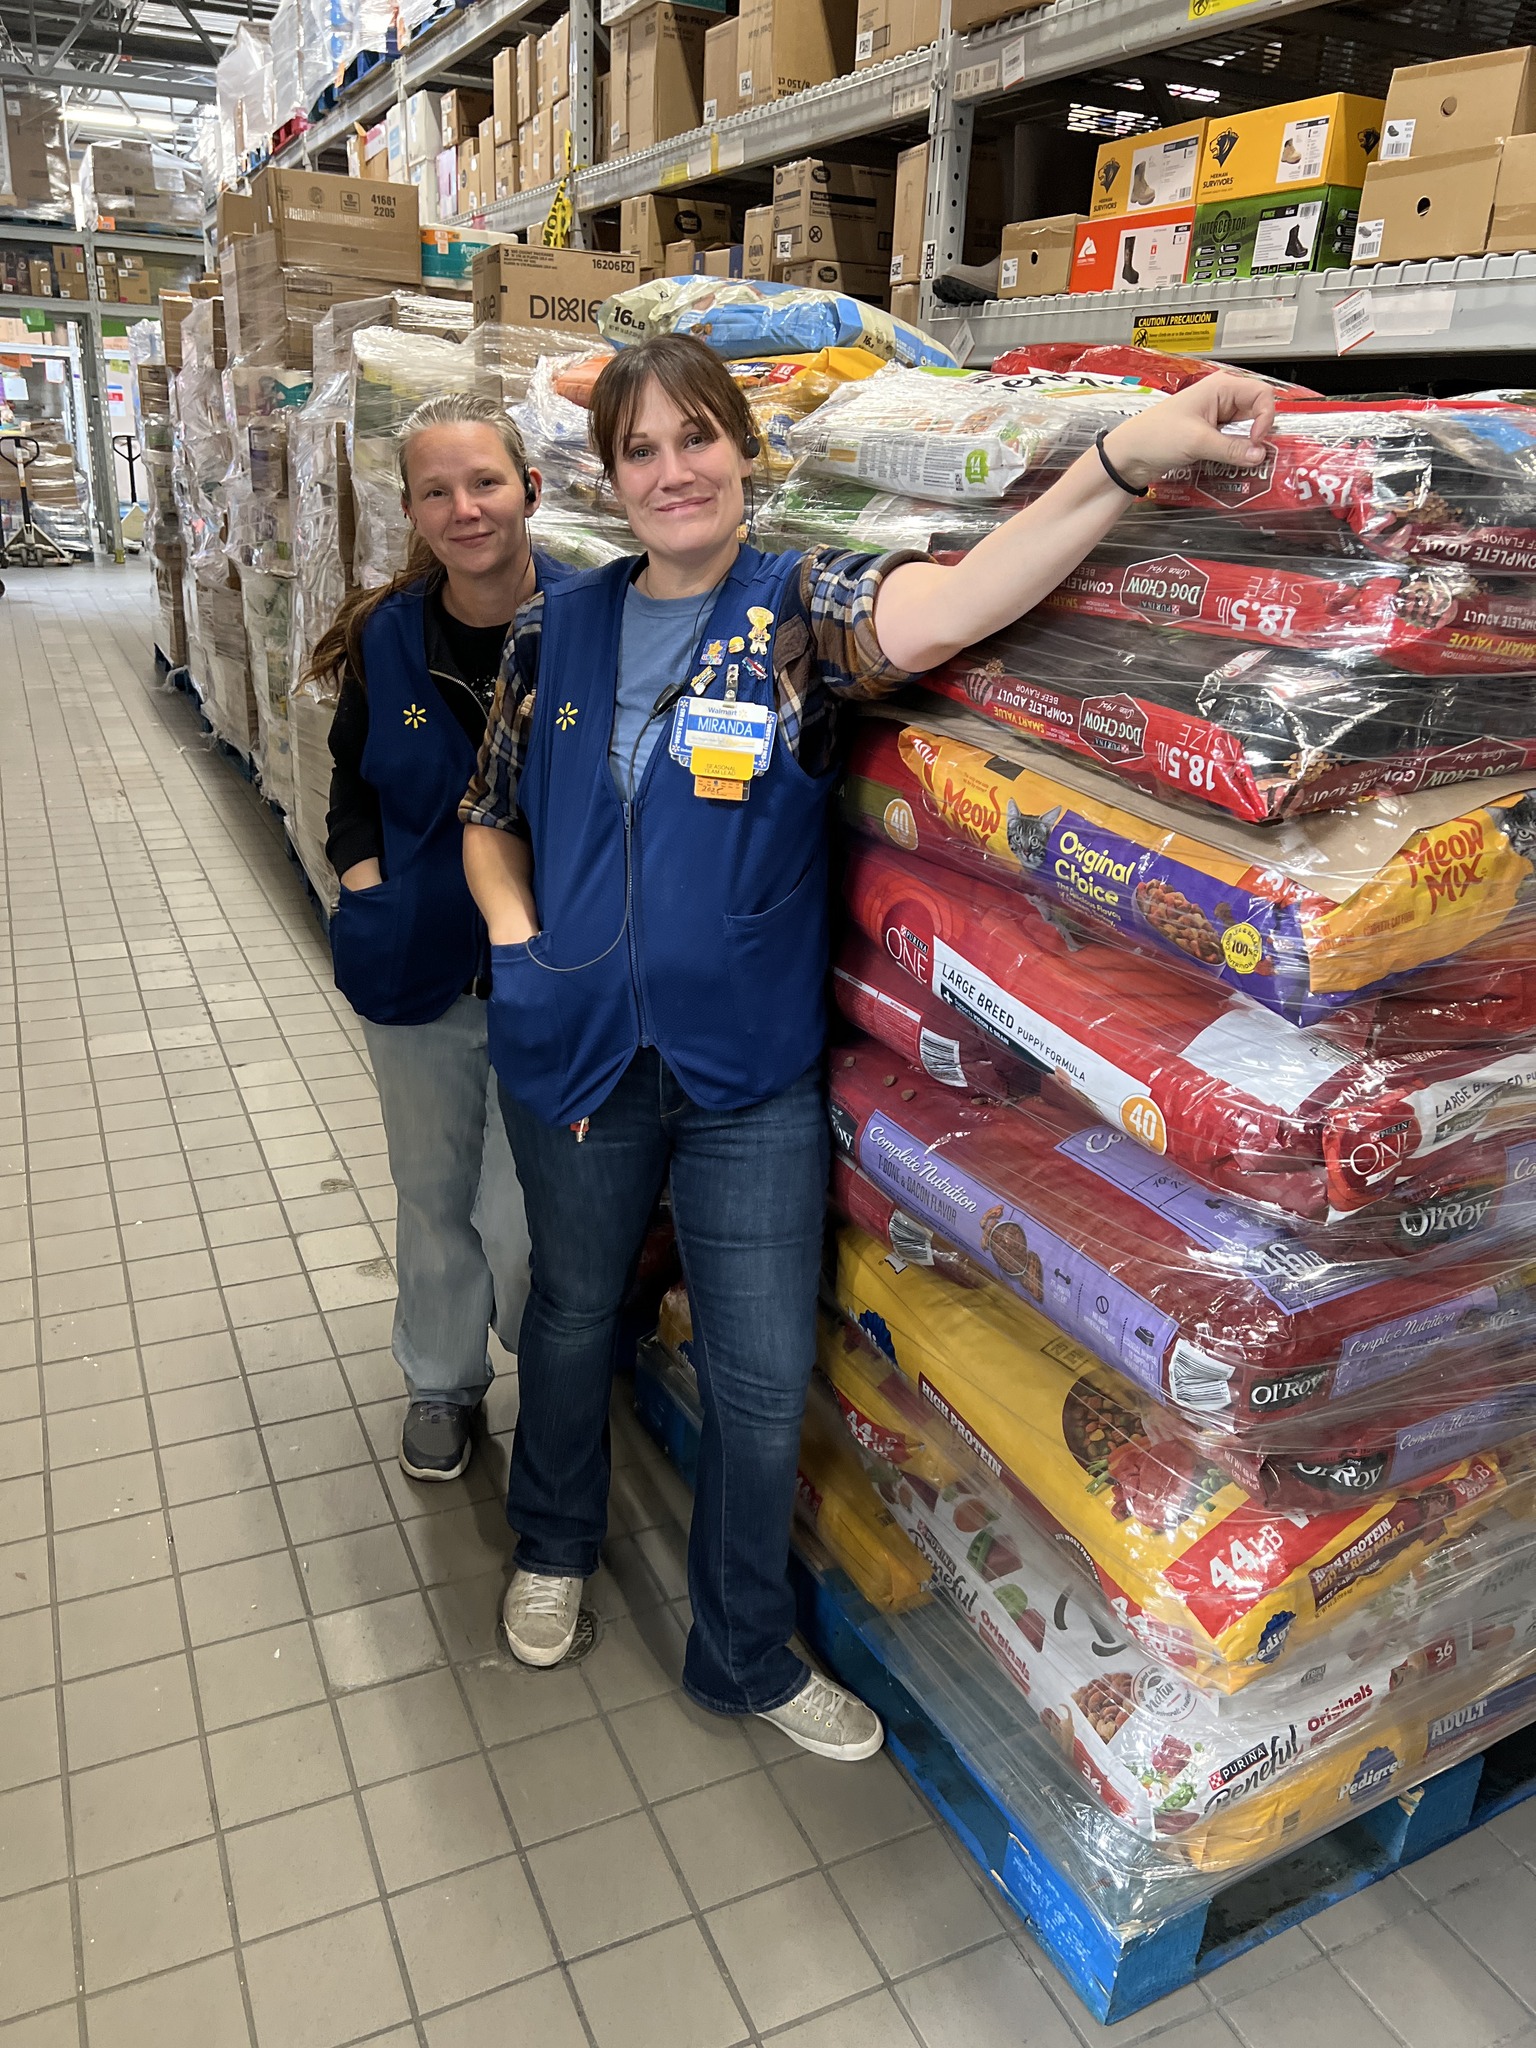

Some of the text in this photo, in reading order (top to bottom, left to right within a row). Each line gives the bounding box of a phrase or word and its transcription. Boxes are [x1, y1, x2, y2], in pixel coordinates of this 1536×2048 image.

[371, 193, 397, 207] 41681
[1203, 177, 1234, 189] SURVIVORS
[373, 206, 396, 218] 2205
[1093, 202, 1117, 213] SURVIVORS
[1199, 216, 1248, 236] INTERCEPTOR
[592, 258, 635, 274] 16206 24
[1138, 315, 1167, 327] CAUTION
[1170, 311, 1212, 325] PRECAUCIÓN
[1482, 534, 1526, 548] FLAVOR
[1125, 576, 1201, 605] DOG CHOW
[1463, 610, 1499, 626] ADULT
[1449, 633, 1488, 650] VALUE
[708, 706, 738, 717] Walmart
[996, 687, 1074, 726] COMPLETE ADULT
[1015, 683, 1059, 705] BEEF FLAVOR
[674, 727, 683, 744] WEST
[697, 715, 754, 737] MIRANDA
[993, 705, 1046, 734] SMART VALUE
[1081, 711, 1143, 747] DOG CHOW
[703, 768, 720, 776] TEAM
[943, 777, 1001, 834] Meow
[1059, 831, 1136, 885] Original
[1054, 858, 1120, 907] Choice
[886, 926, 929, 984] ONE
[904, 927, 929, 954] PURINA
[942, 962, 1087, 1083] LARGE BREED PUPPY FORMULA
[1435, 1085, 1471, 1119] LARGE
[1128, 1102, 1158, 1142] 40
[869, 1126, 922, 1173] Complete
[918, 1160, 977, 1214] Nutrition
[877, 1153, 901, 1185] T-BONE
[906, 1177, 931, 1208] BACON
[931, 1192, 958, 1227] FLAVOR
[1349, 1327, 1404, 1357] Complete
[1403, 1310, 1456, 1338] Nutrition
[1250, 1373, 1323, 1406] Ol'Roy
[921, 1380, 1003, 1477] HIGH PROTEIN
[924, 1526, 957, 1574] PURINA
[1342, 1517, 1393, 1565] PROTEIN
[1350, 1520, 1406, 1570] RED MEAT
[1209, 1538, 1251, 1589] 44
[980, 1609, 1030, 1682] Originals
[1434, 1641, 1454, 1664] 36
[1306, 1683, 1374, 1733] Originals
[1430, 1698, 1489, 1742] ADULT
[1204, 1723, 1299, 1815] Beneful
[1221, 1746, 1267, 1781] PURINA
[1337, 1757, 1406, 1802] Pedigree
